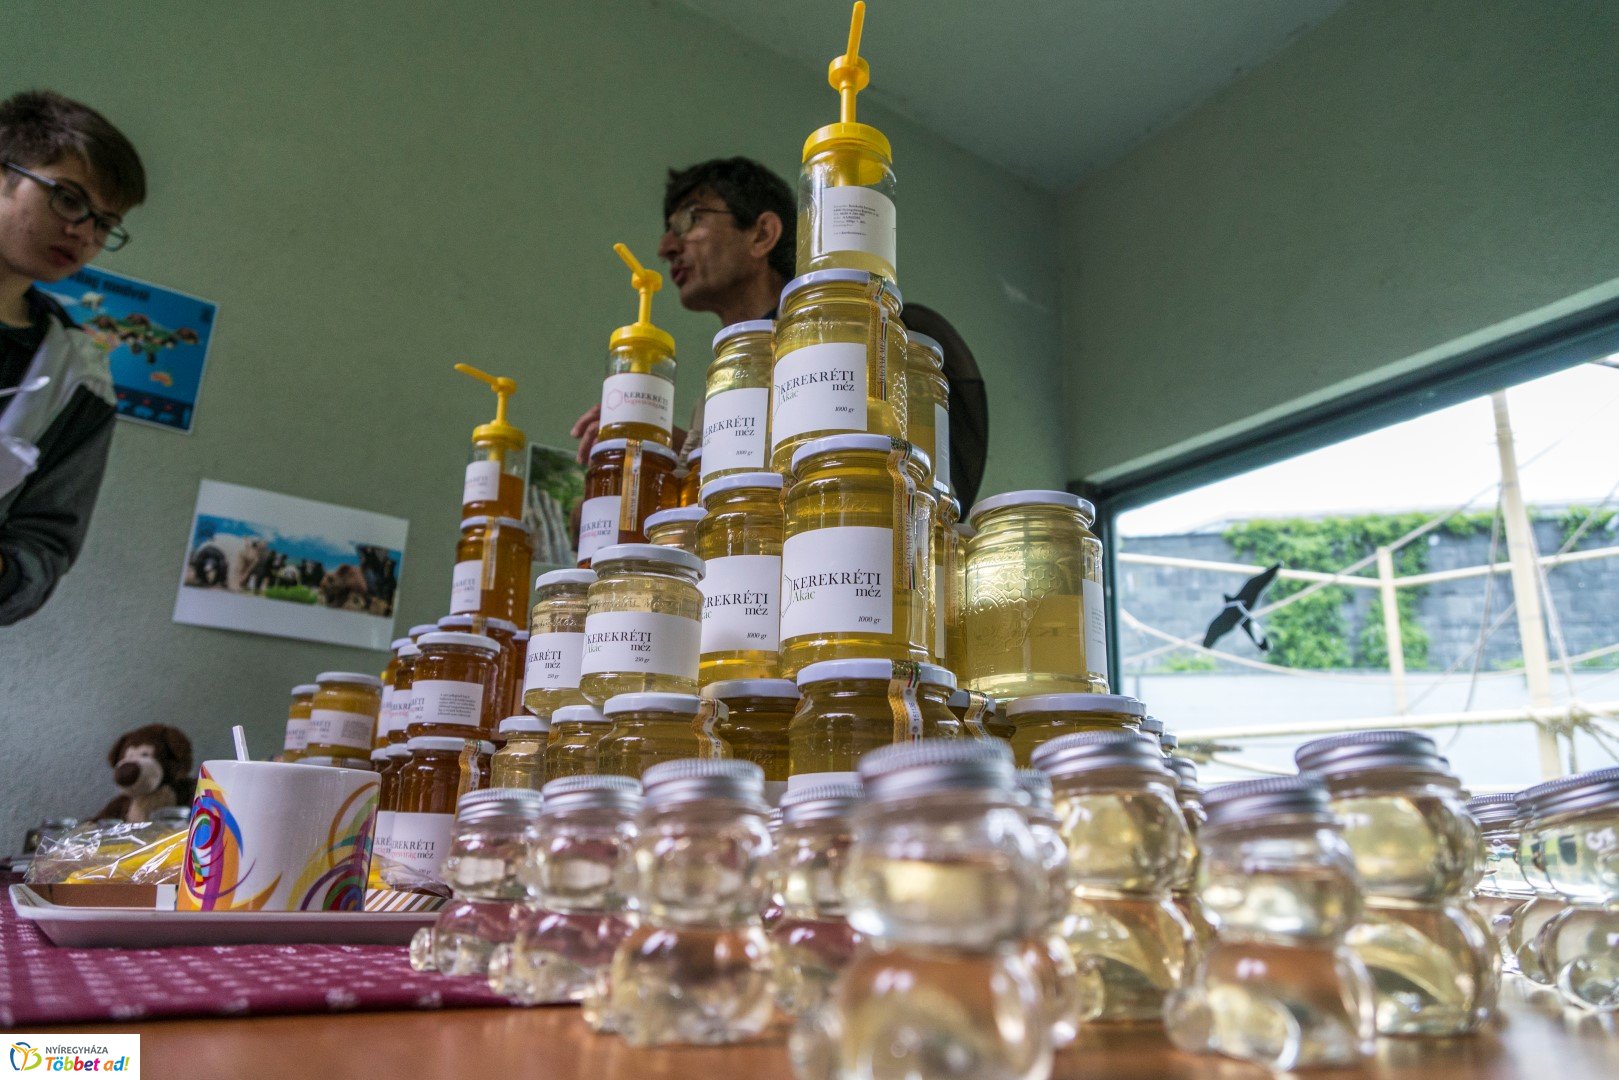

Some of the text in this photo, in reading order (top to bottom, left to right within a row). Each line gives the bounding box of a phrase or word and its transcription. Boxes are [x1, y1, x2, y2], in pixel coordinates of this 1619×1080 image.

[780, 368, 855, 395] KEREKRÉTI
[832, 380, 855, 392] méz
[735, 427, 755, 437] méz
[793, 569, 882, 591] KEREKRÉTI
[793, 585, 882, 603] Akác méz
[745, 604, 769, 616] méz
[587, 629, 652, 645] KEREKRÉTI
[631, 642, 651, 652] méz
[545, 660, 561, 669] méz
